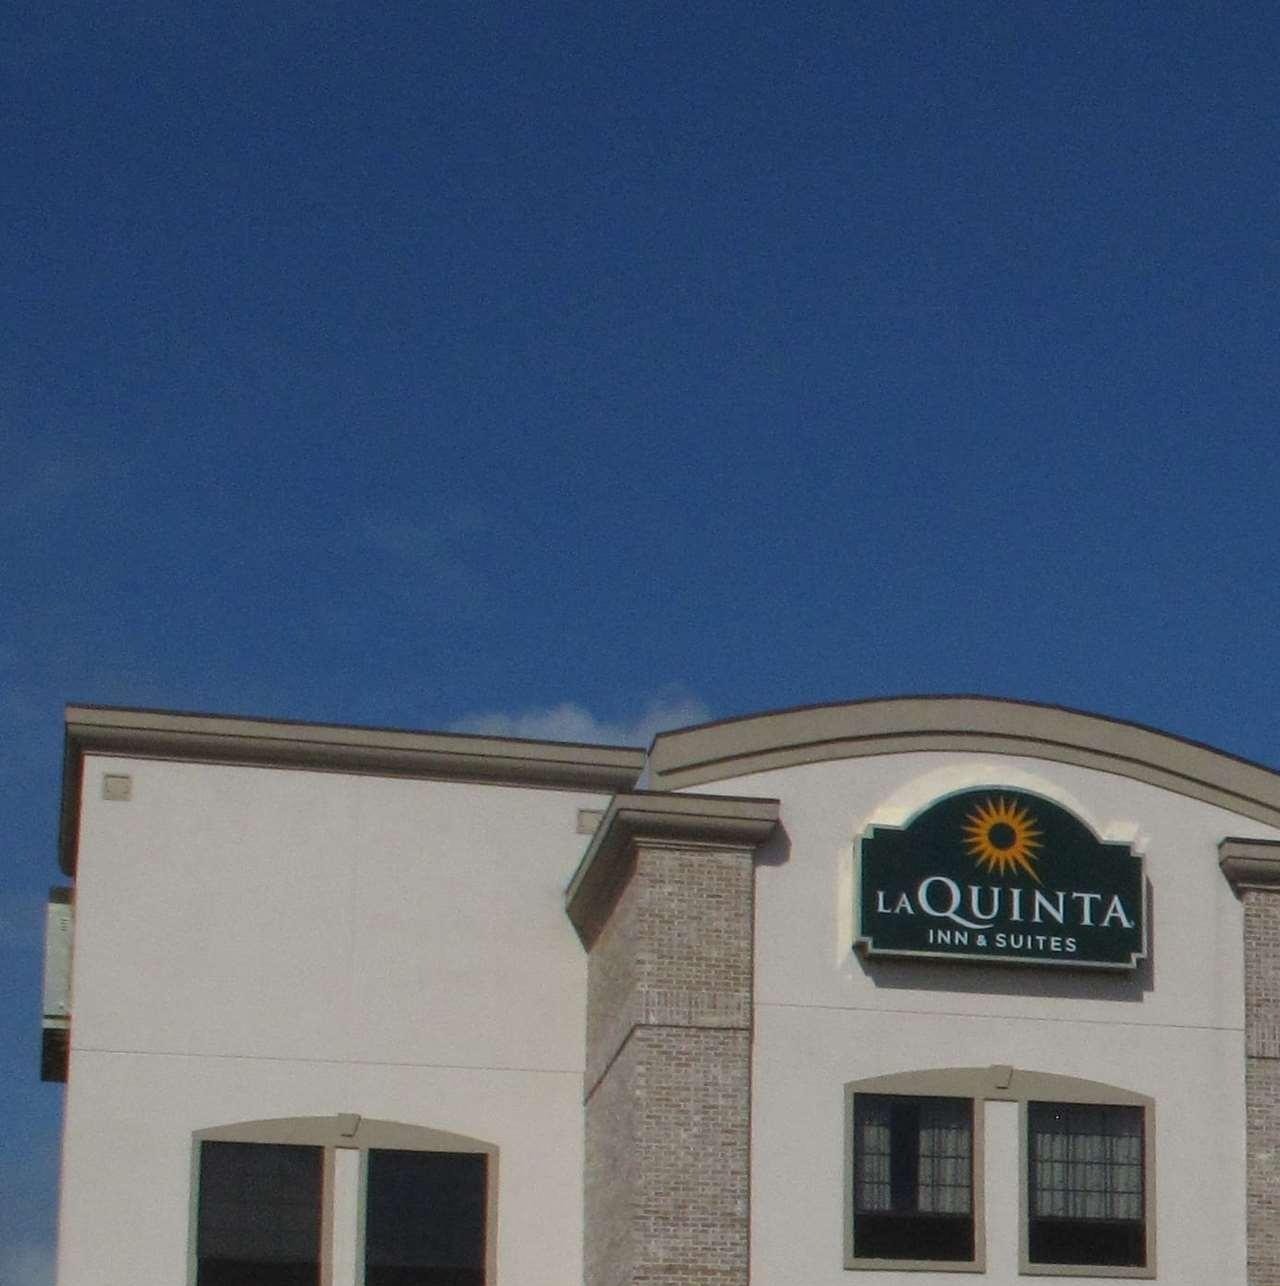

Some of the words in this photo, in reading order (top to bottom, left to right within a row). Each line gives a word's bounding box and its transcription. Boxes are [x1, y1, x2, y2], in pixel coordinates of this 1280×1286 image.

[929, 929, 968, 945] INN
[976, 934, 987, 946] &
[995, 932, 1077, 952] SUITES
